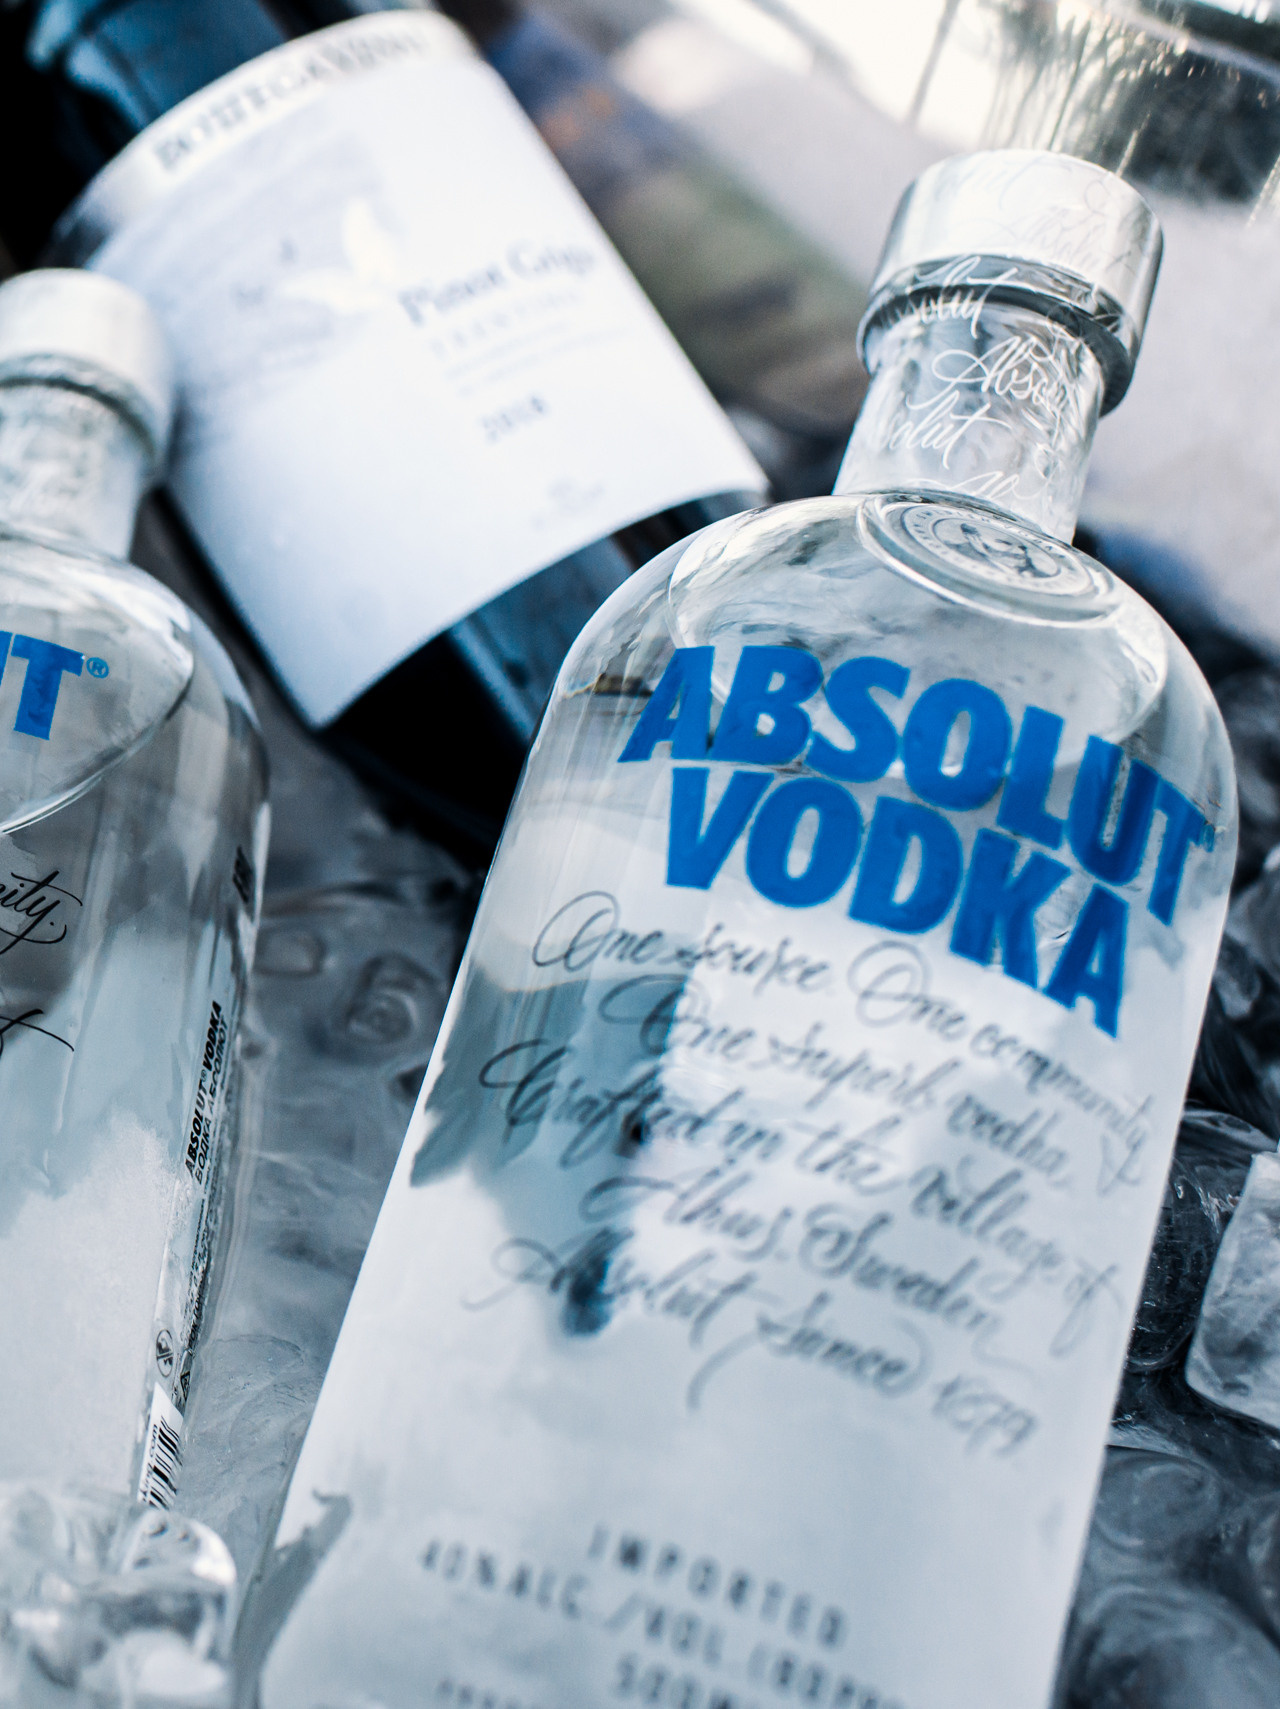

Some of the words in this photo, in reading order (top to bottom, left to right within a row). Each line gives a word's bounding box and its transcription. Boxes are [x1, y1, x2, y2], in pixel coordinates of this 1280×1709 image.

[617, 645, 1208, 926] ABSOLUT
[532, 890, 664, 972] One
[665, 767, 1129, 1040] VODKA
[202, 1000, 222, 1072] VODKA
